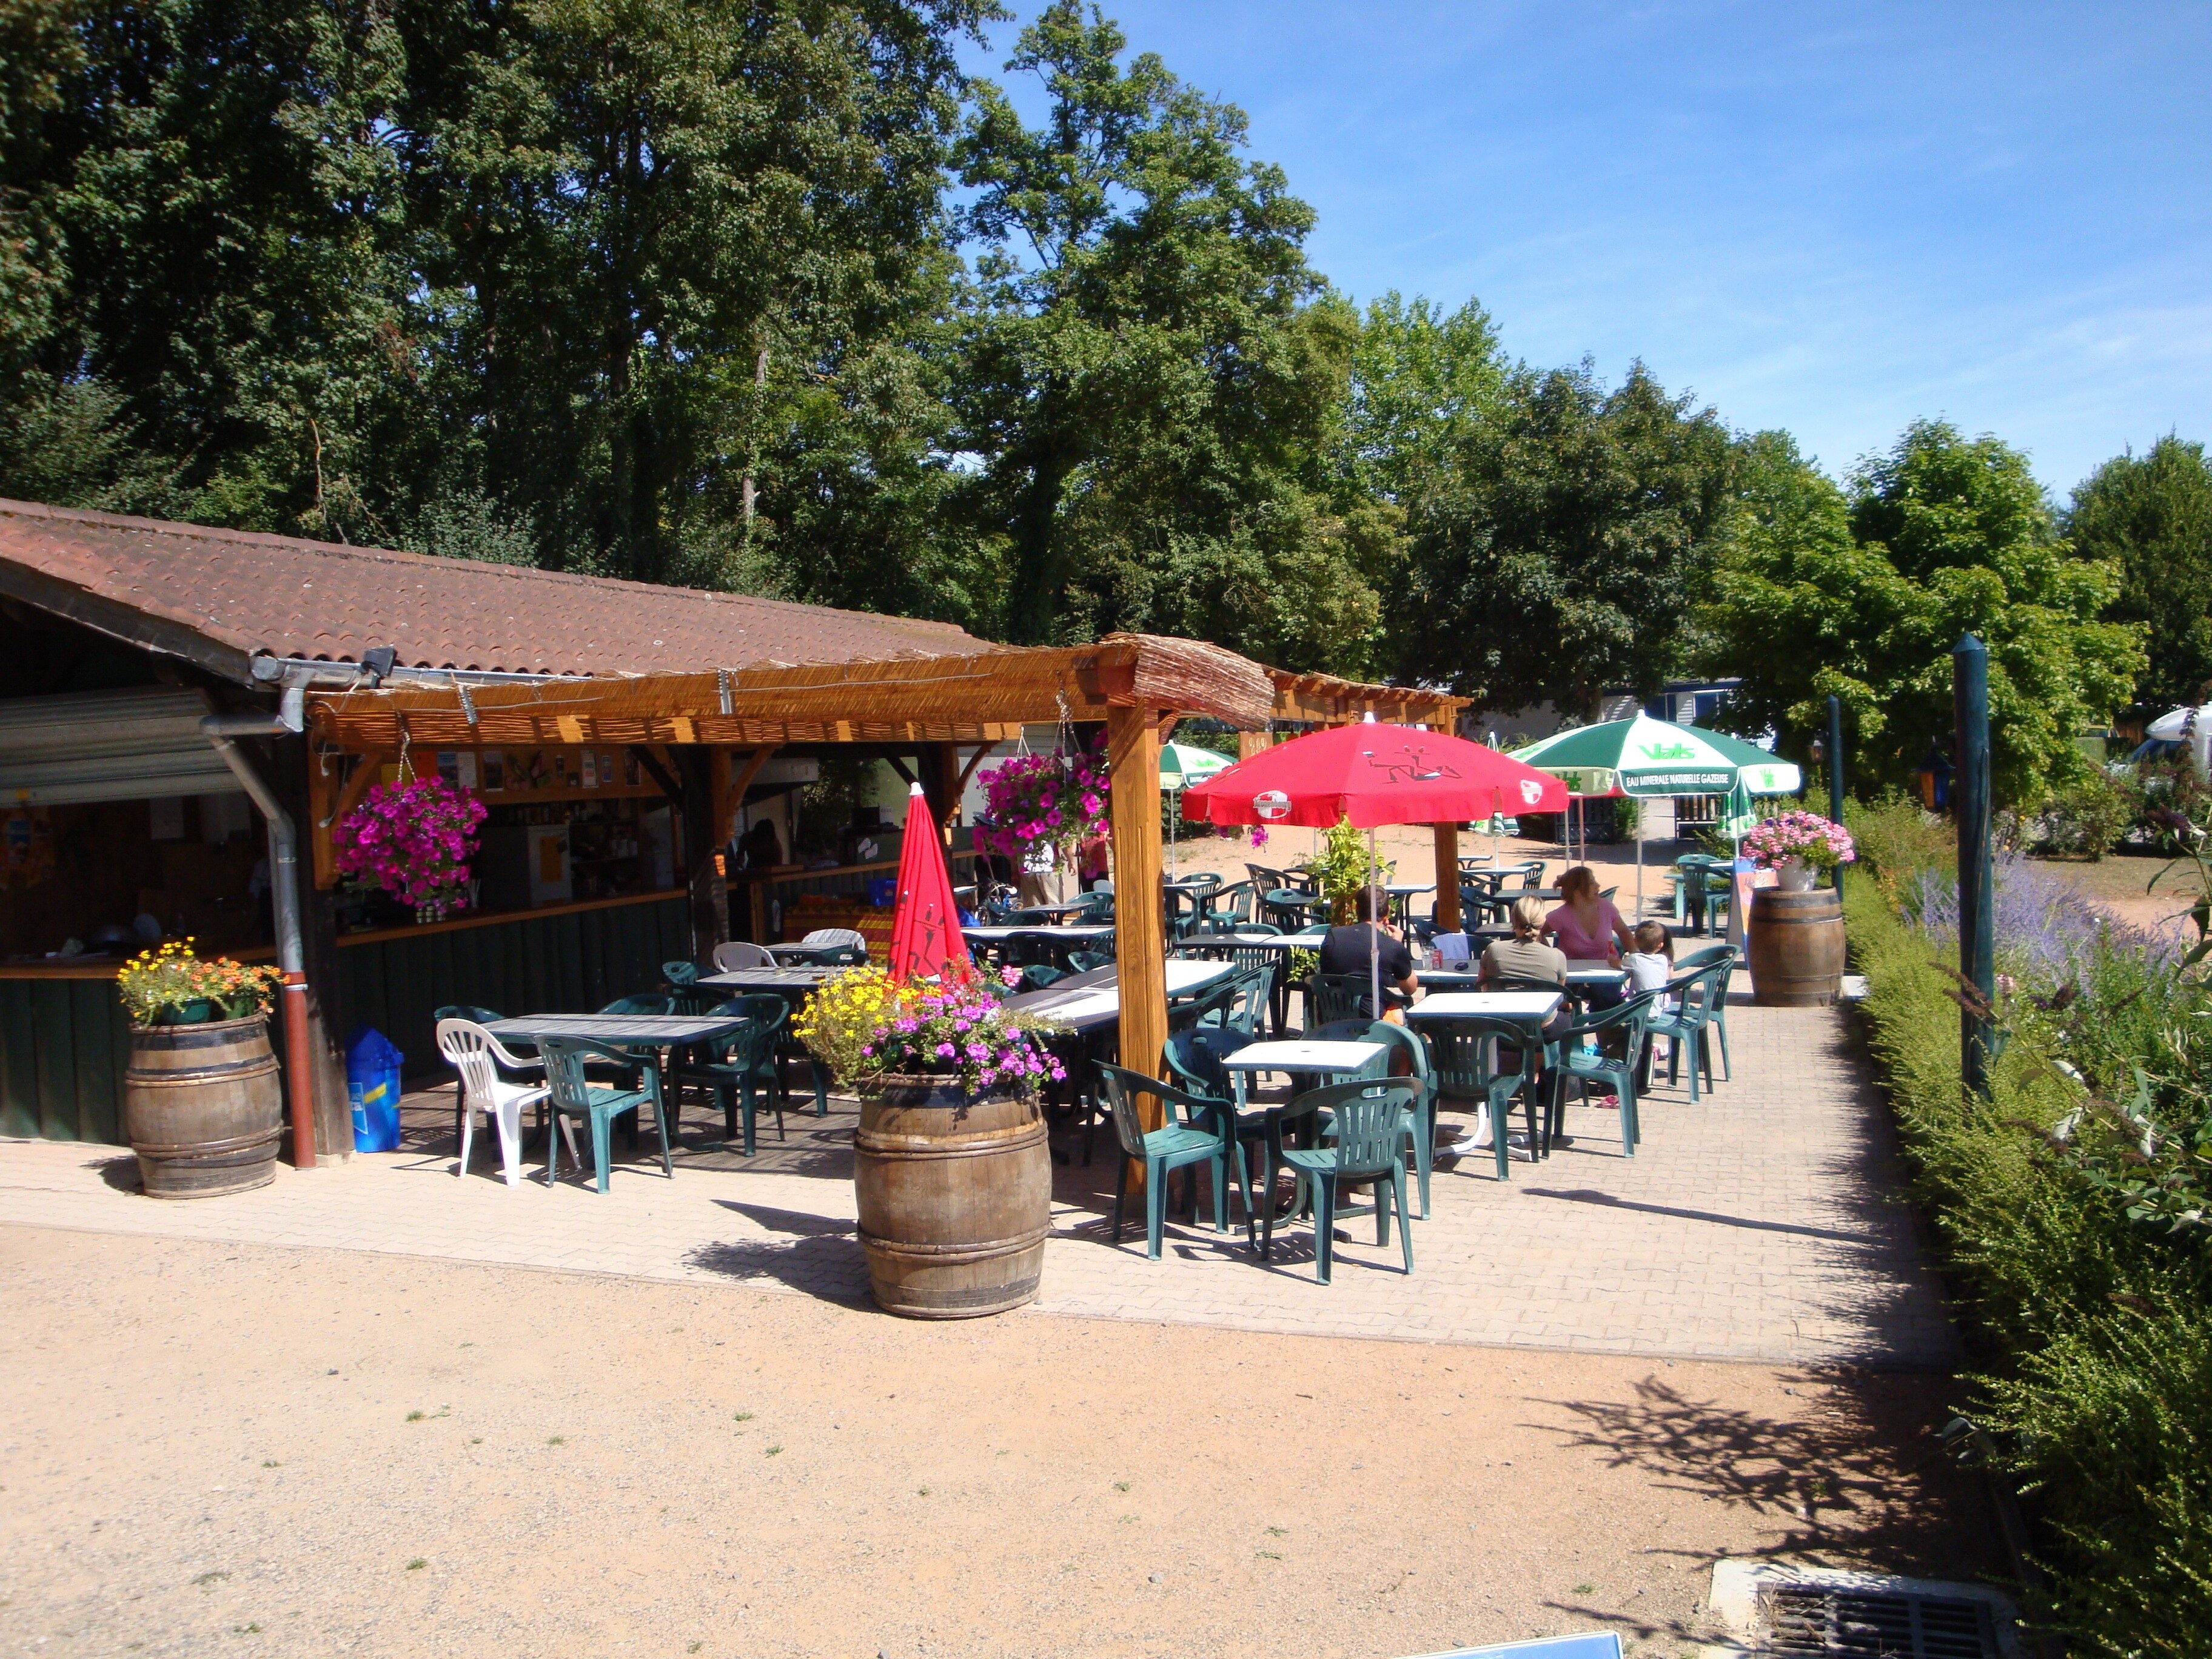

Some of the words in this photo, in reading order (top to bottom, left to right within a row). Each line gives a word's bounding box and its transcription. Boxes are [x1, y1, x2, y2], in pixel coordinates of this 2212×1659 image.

[1638, 743, 1695, 759] Vals
[1626, 777, 1639, 787] EAU
[1640, 775, 1669, 786] MINERALE
[1669, 774, 1700, 784] NATURELLE
[1701, 774, 1729, 784] GAZEUSE
